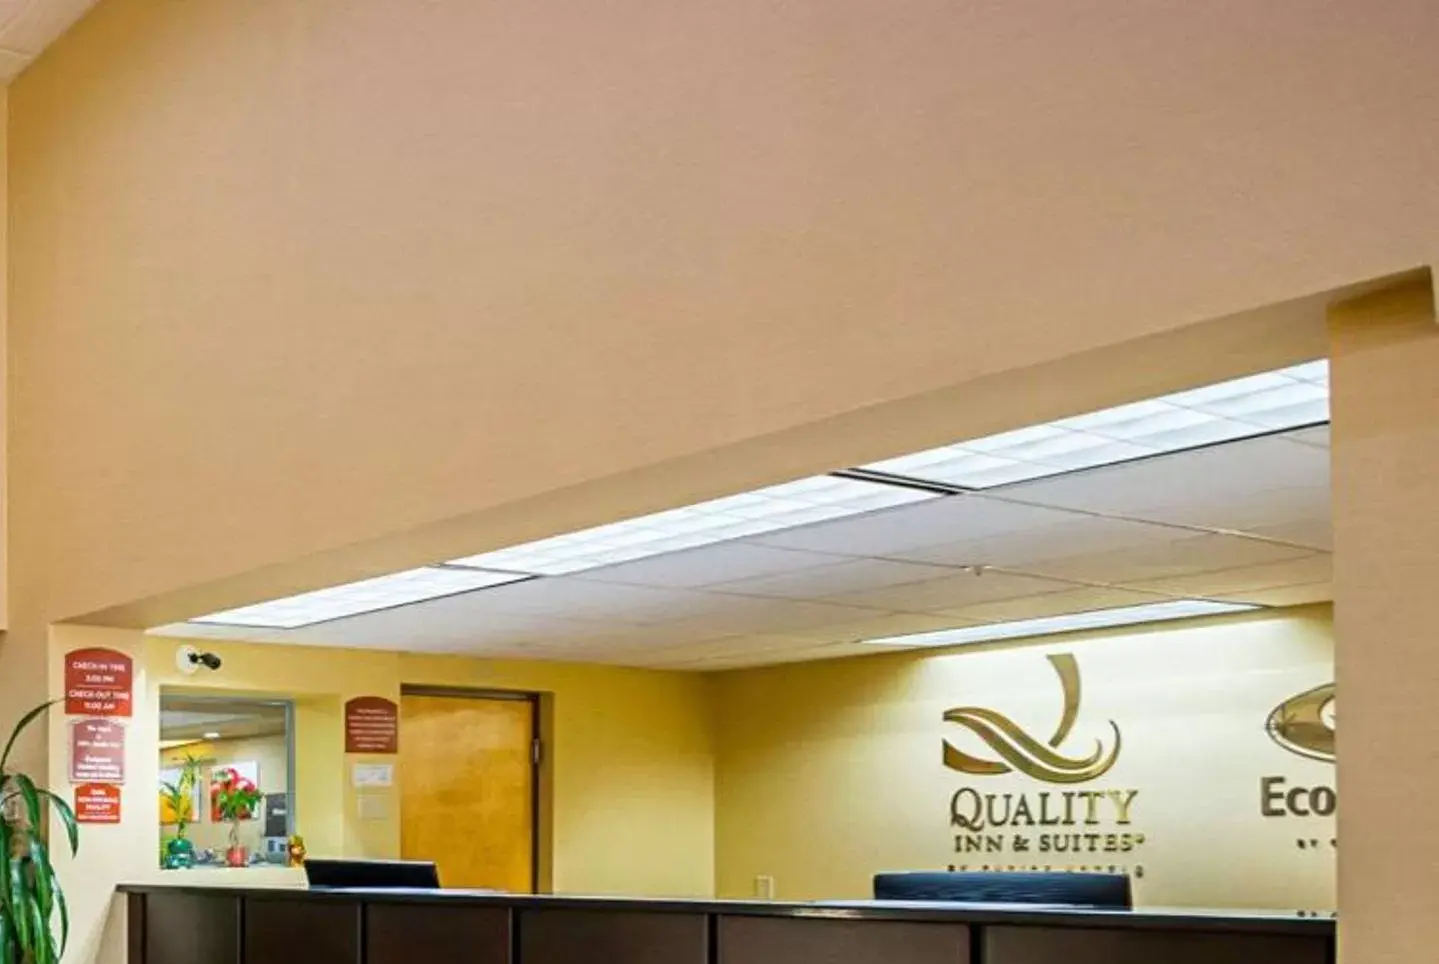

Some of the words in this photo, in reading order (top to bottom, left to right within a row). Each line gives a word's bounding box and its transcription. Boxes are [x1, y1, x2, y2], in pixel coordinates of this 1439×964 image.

[71, 662, 107, 671] CHECK-IN
[69, 690, 111, 699] CHECK-OUT
[950, 787, 1139, 832] QUALITY
[954, 834, 1004, 852] INN
[1012, 834, 1030, 852] &
